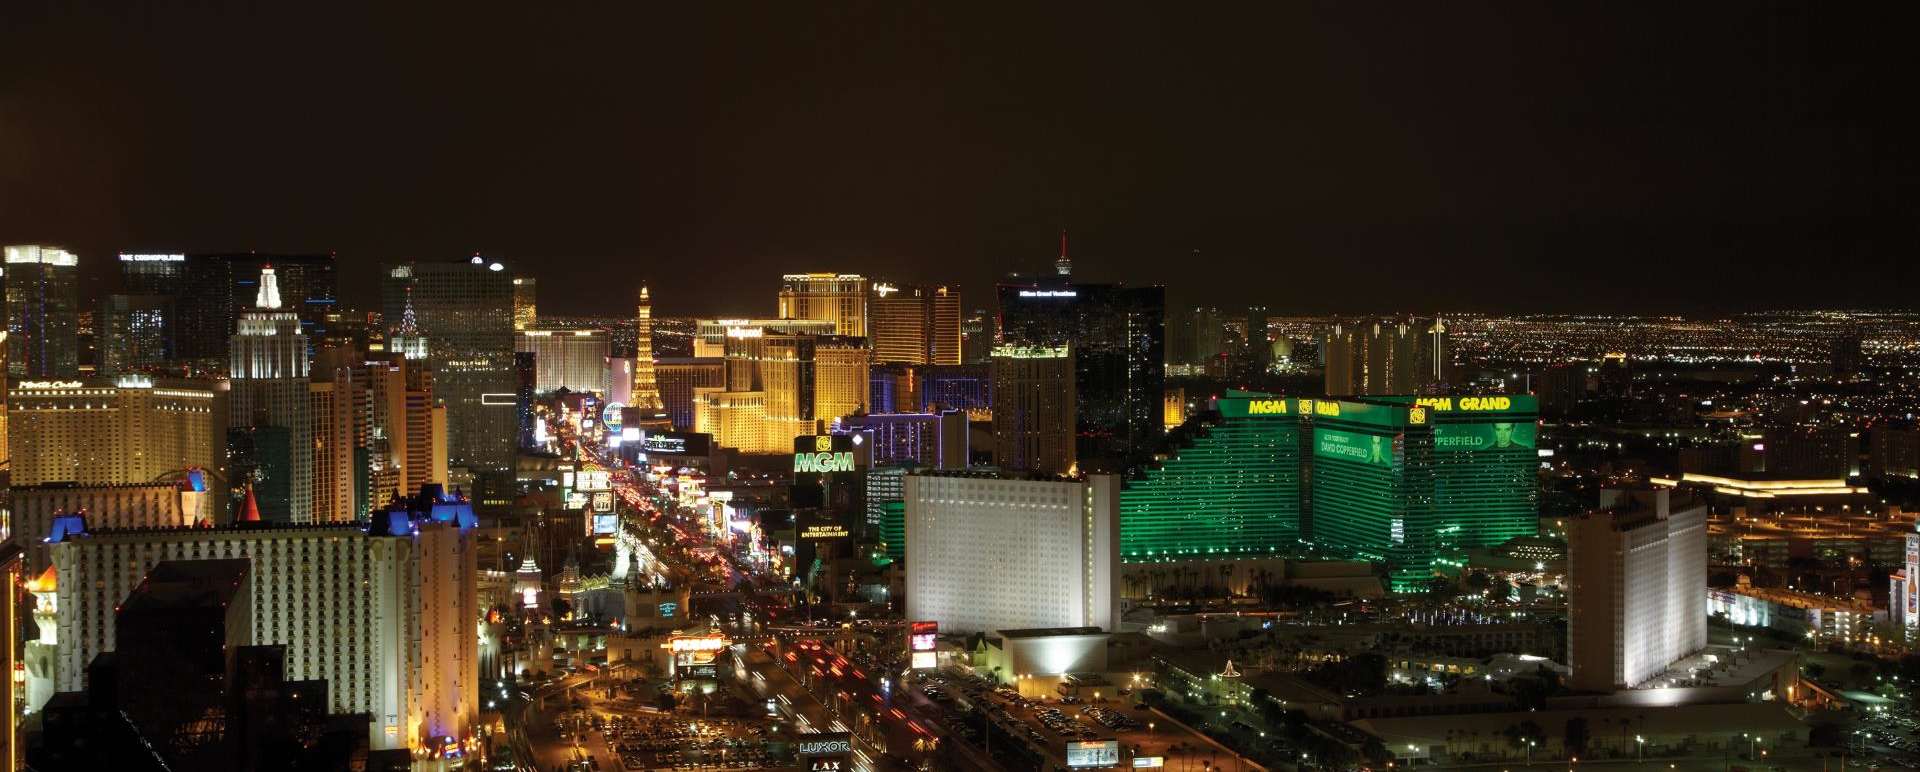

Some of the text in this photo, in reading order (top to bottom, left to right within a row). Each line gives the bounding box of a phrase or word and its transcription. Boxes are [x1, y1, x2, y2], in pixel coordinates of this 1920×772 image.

[727, 326, 762, 340] hollywood
[1248, 400, 1287, 414] MGM
[1459, 397, 1511, 410] GRAND
[1336, 444, 1368, 458] COPPERFIELD
[794, 452, 854, 473] MGM
[800, 741, 851, 753] LUXOR
[812, 761, 841, 771] LAX
